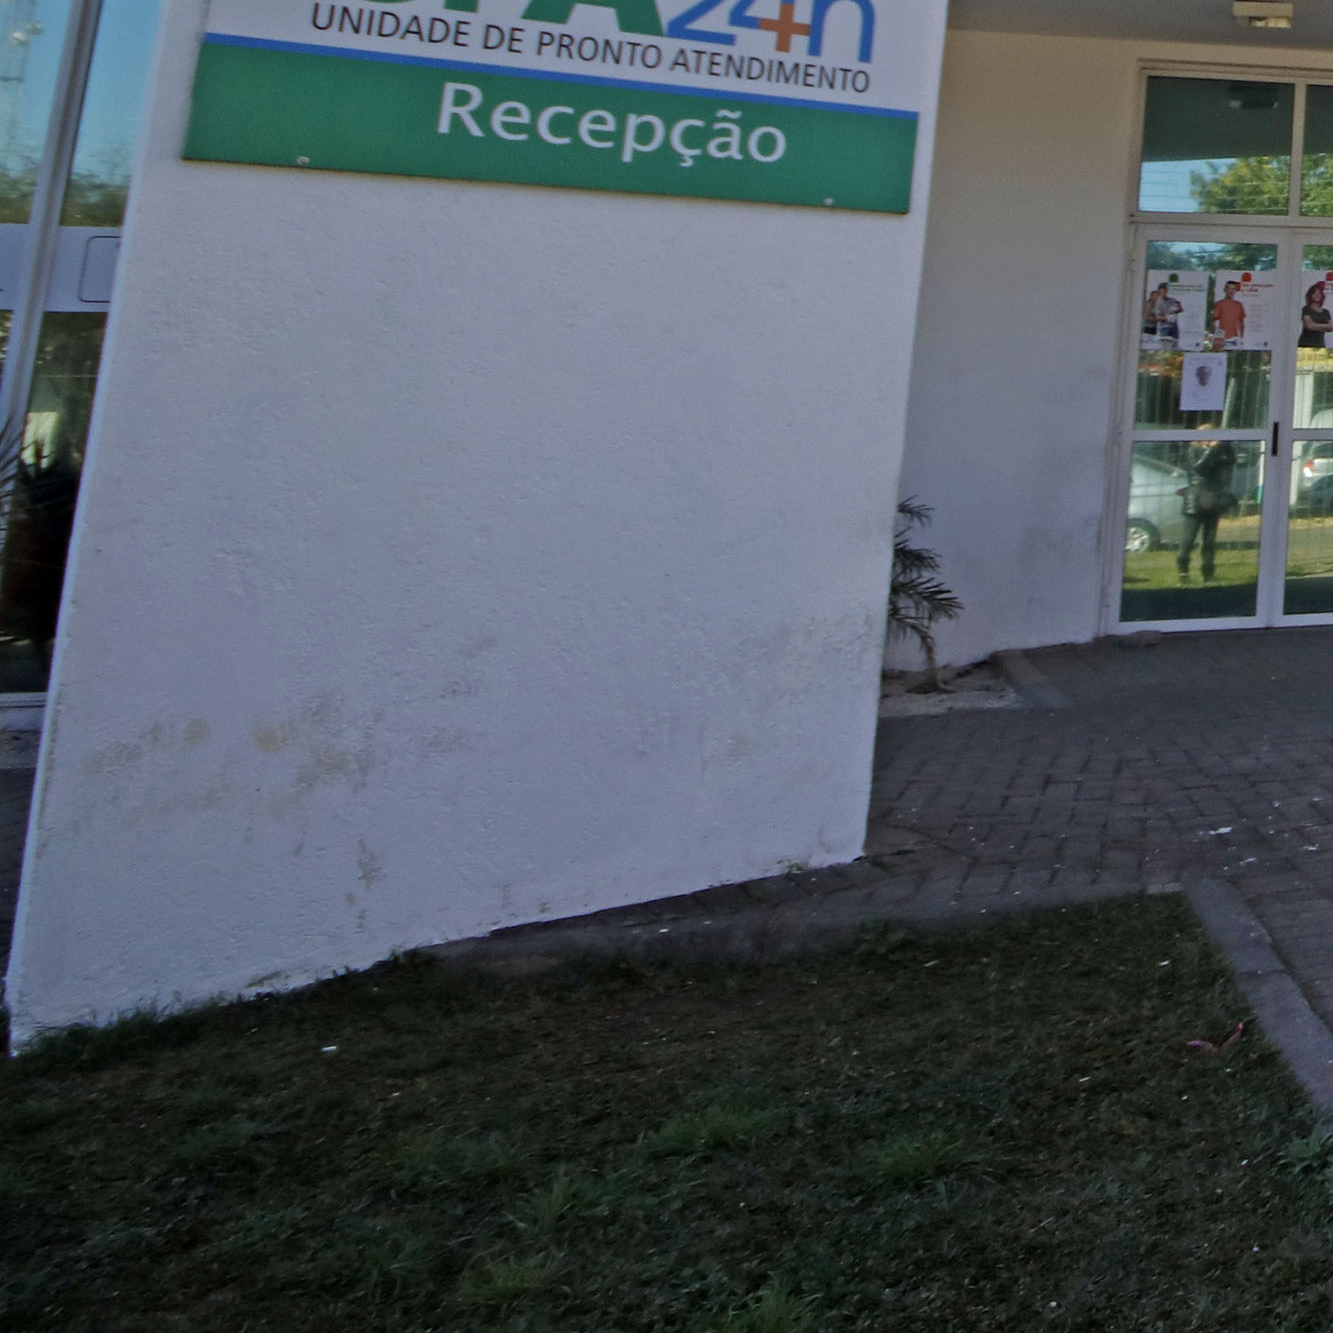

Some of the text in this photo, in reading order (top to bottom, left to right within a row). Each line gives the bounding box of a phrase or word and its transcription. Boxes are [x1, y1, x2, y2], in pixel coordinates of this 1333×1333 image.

[312, 2, 870, 93] UNIDADE DE PRONTO ATENDIMENTO
[437, 81, 786, 166] Recepção
